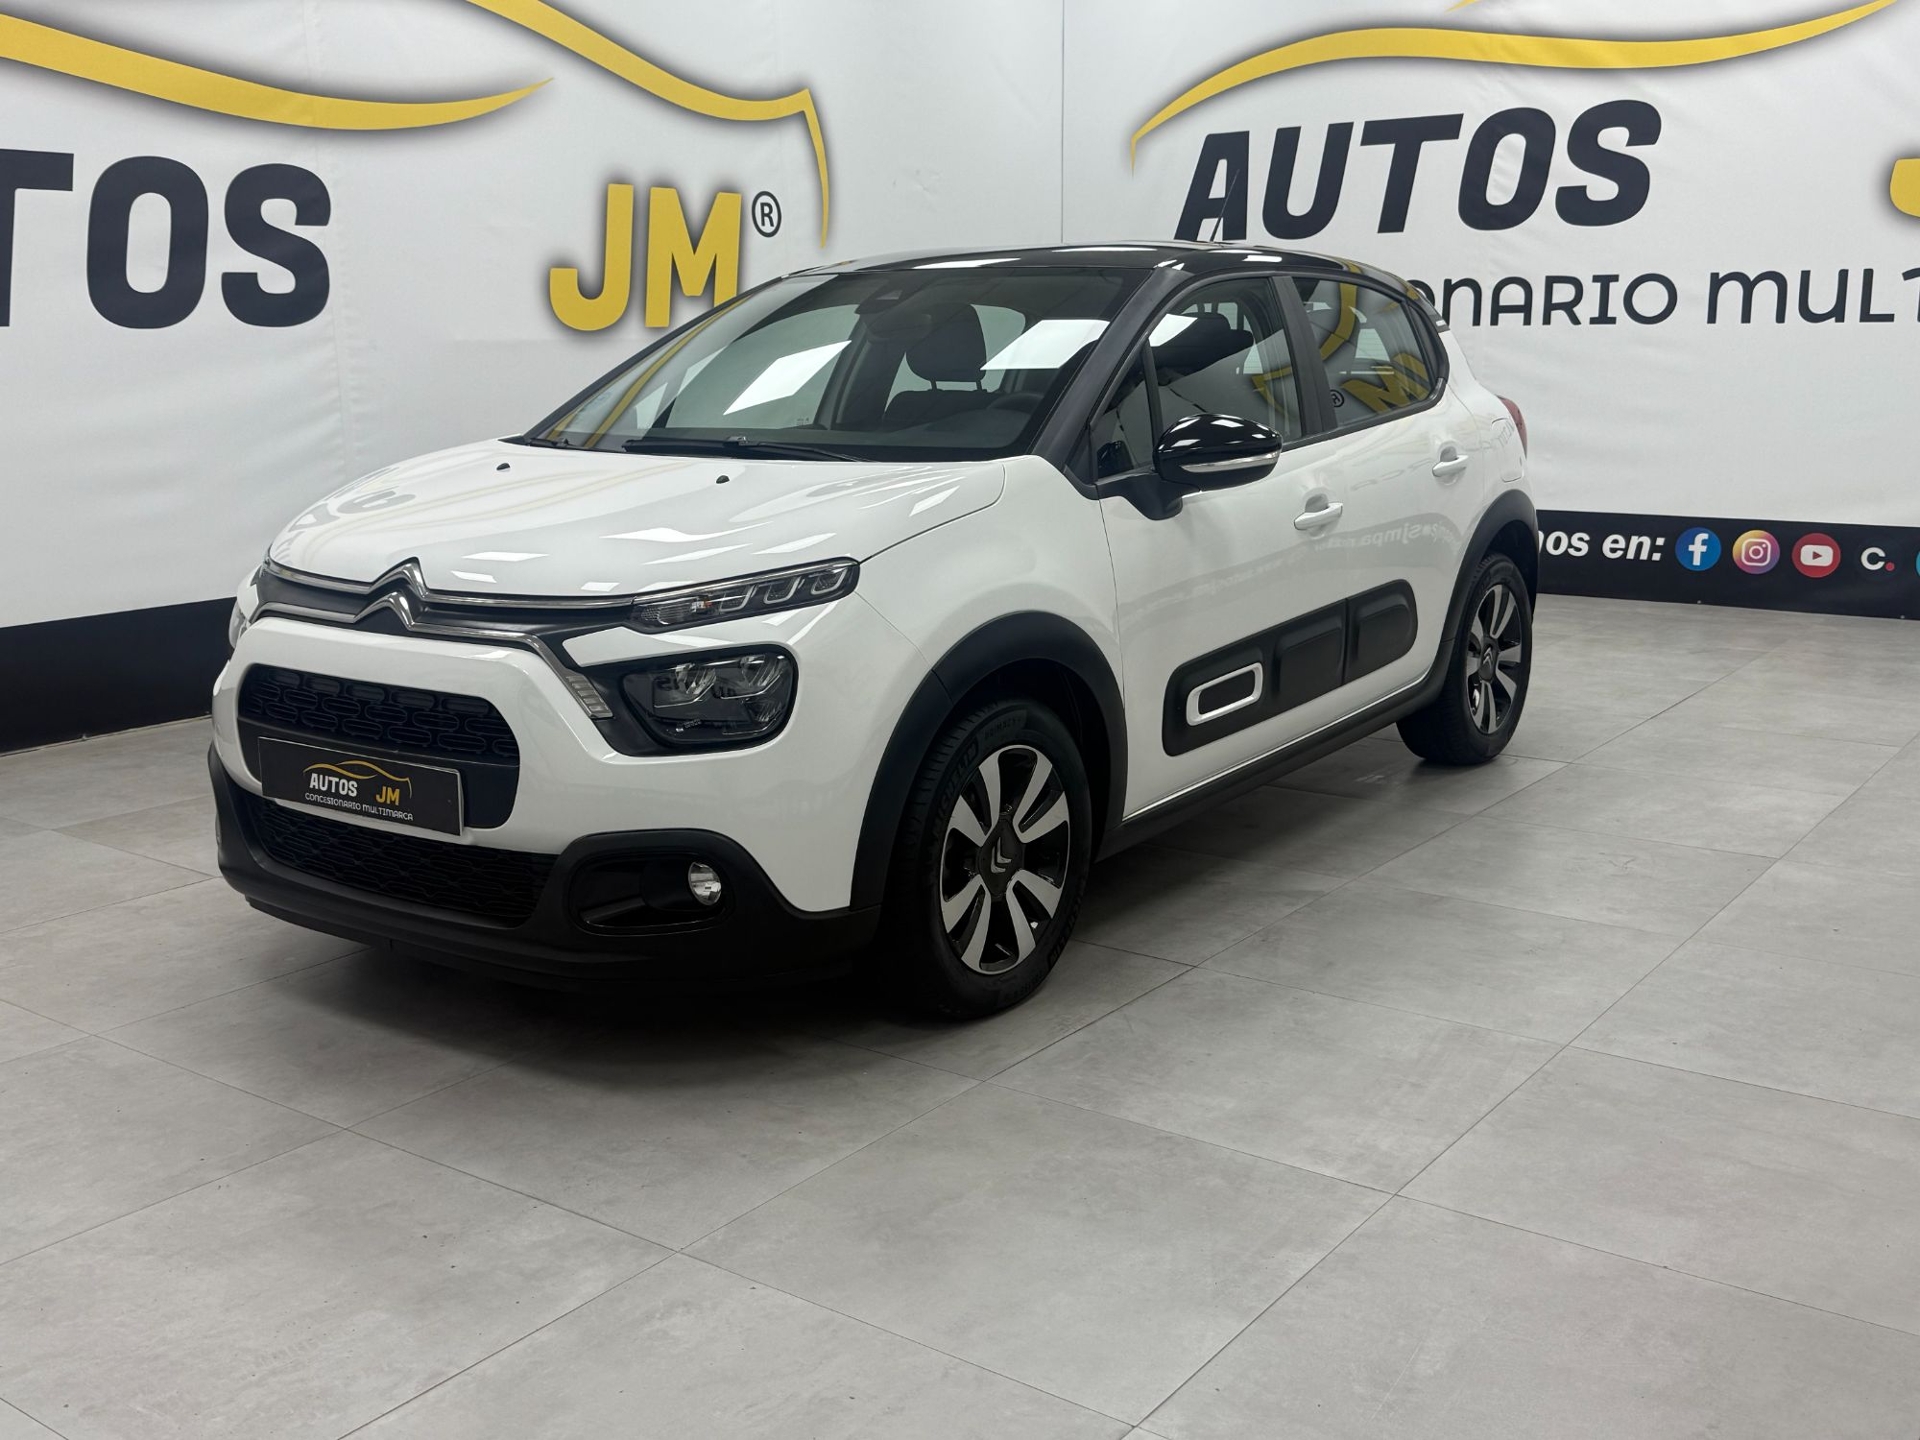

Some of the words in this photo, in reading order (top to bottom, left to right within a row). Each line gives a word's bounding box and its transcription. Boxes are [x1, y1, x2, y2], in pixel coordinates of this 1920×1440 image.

[1174, 99, 1661, 241] AUTOS
[1602, 534, 1665, 561] en:
[309, 772, 358, 797] AUTOS
[375, 786, 400, 806] JM
[305, 792, 361, 810] CONCESIONARIO
[362, 804, 414, 820] MULTIMARCA
